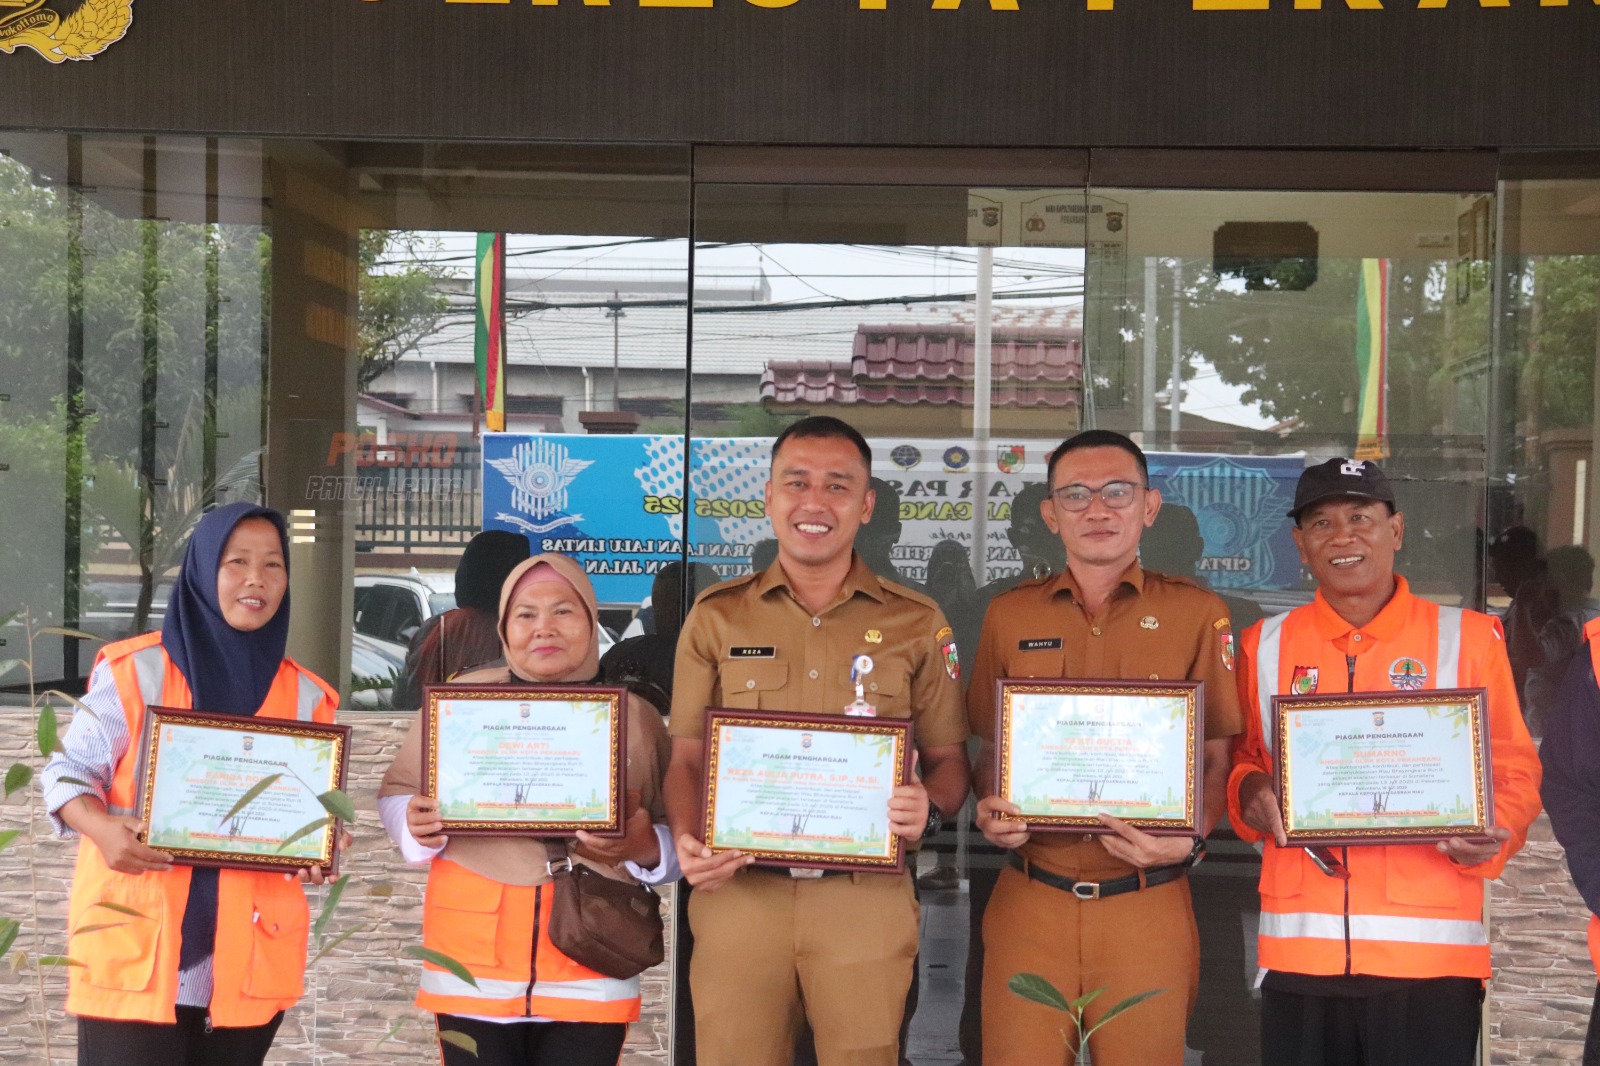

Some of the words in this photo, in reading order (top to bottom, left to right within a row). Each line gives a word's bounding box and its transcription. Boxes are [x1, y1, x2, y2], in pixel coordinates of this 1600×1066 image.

[326, 432, 458, 467] POSKO
[306, 476, 381, 500] PATUH
[387, 477, 464, 501] LANCA
[1353, 749, 1406, 757] SUMARNO
[233, 757, 288, 766] PENGHARGAAN
[792, 754, 848, 763] PENGHARGAAN
[727, 767, 754, 776] REZA
